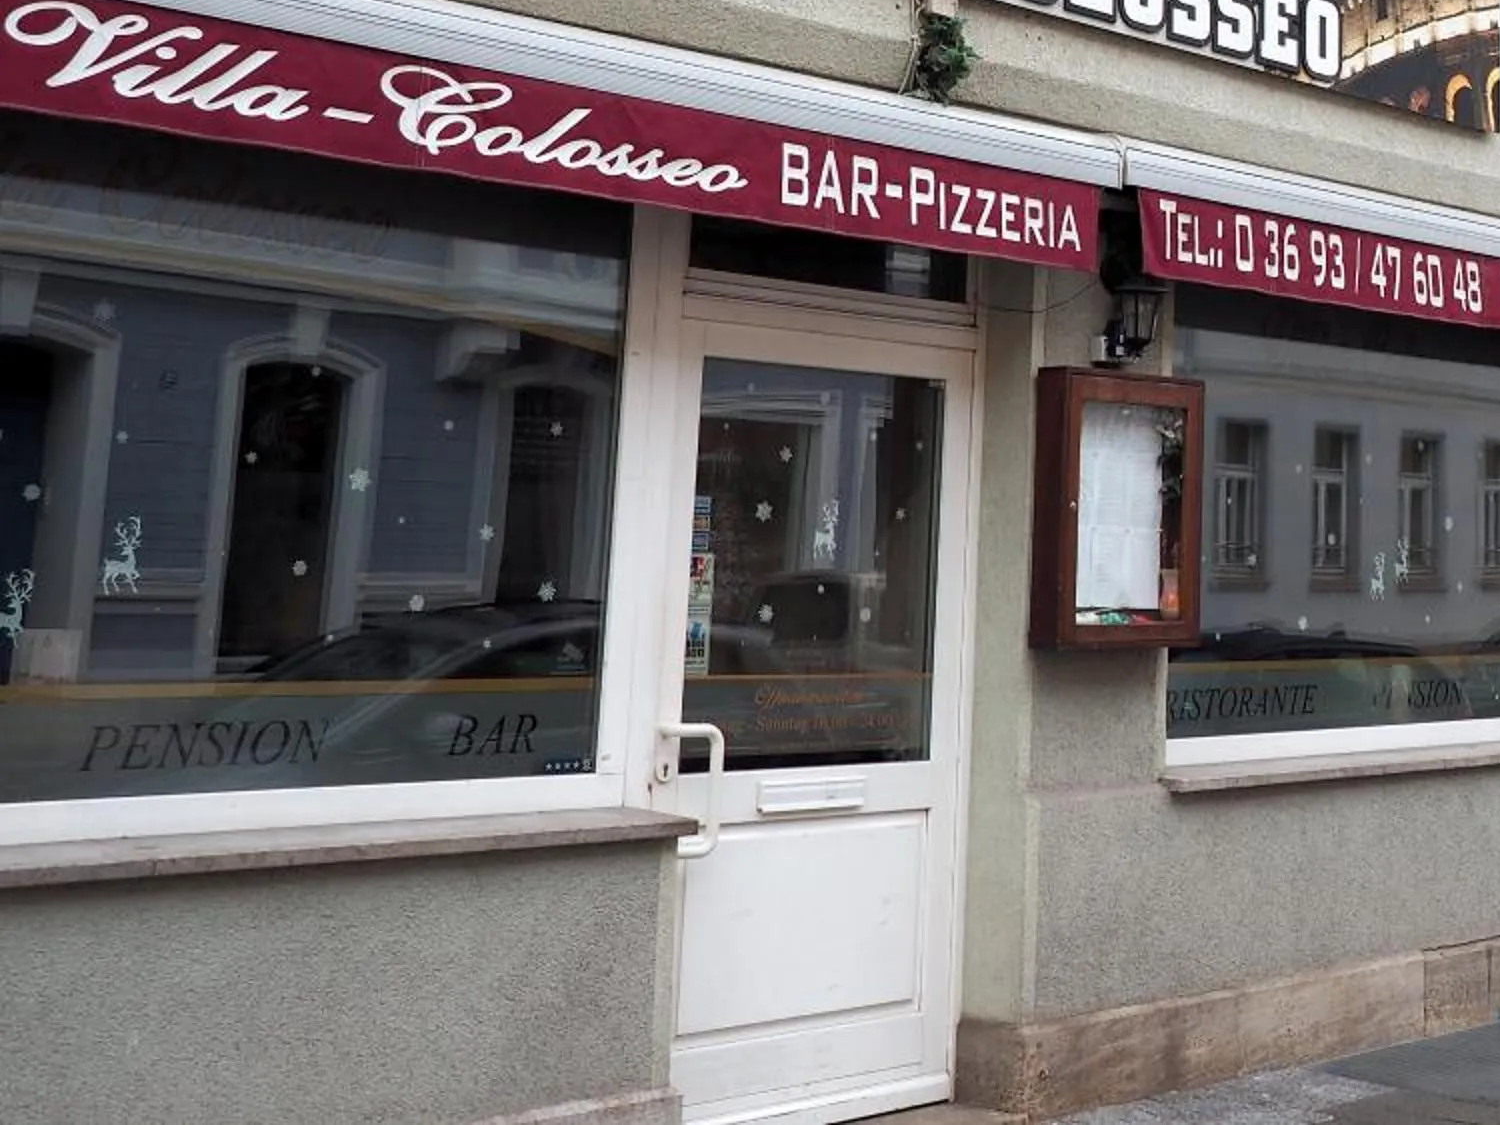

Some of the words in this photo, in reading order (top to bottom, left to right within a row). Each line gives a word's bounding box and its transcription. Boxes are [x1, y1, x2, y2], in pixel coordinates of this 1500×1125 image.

[3, 0, 310, 123] Villa
[380, 65, 749, 194] Colosseo
[780, 141, 1082, 252] BAR-PIZZERIA
[1234, 213, 1255, 273] 0
[1264, 219, 1300, 282] 36
[1309, 229, 1346, 290] 93
[1370, 242, 1401, 301] 47
[1412, 250, 1445, 308] 60
[1453, 257, 1483, 314] 48
[1167, 683, 1319, 722] RISTORANTE
[1373, 679, 1465, 710] PSION
[79, 716, 330, 773] PENSION
[446, 712, 539, 758] BAR
